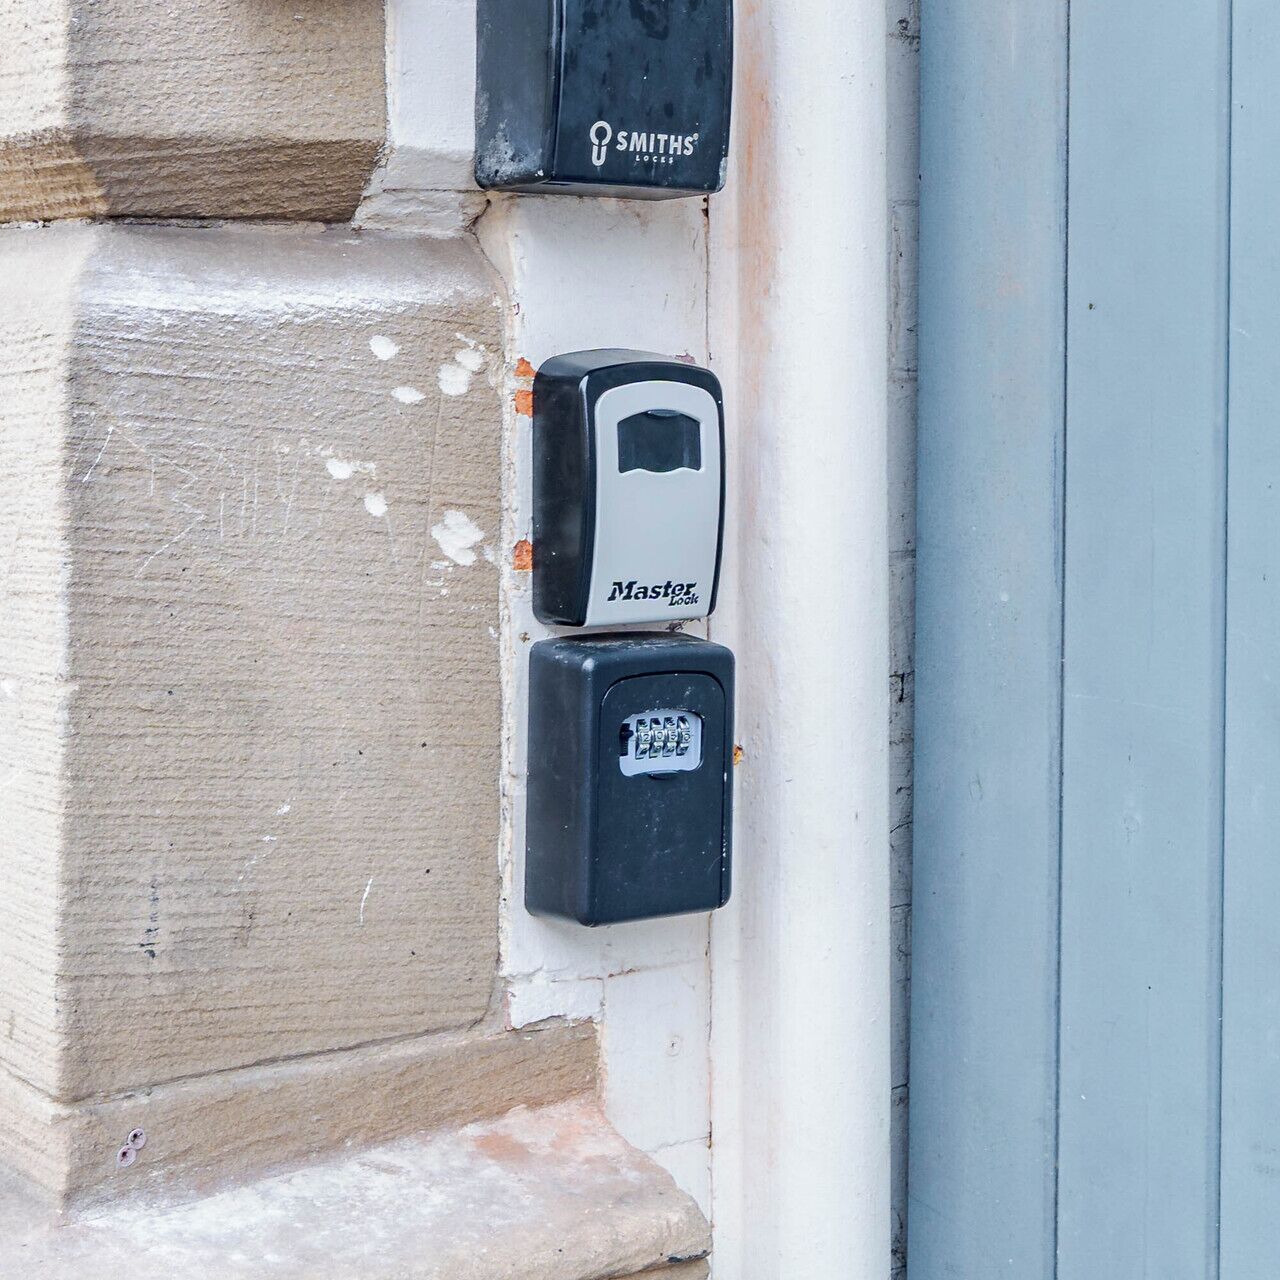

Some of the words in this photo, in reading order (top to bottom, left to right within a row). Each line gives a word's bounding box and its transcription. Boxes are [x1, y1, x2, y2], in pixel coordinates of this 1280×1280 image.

[616, 131, 694, 156] SMITHS
[607, 580, 697, 602] Master
[668, 594, 699, 607] Lock
